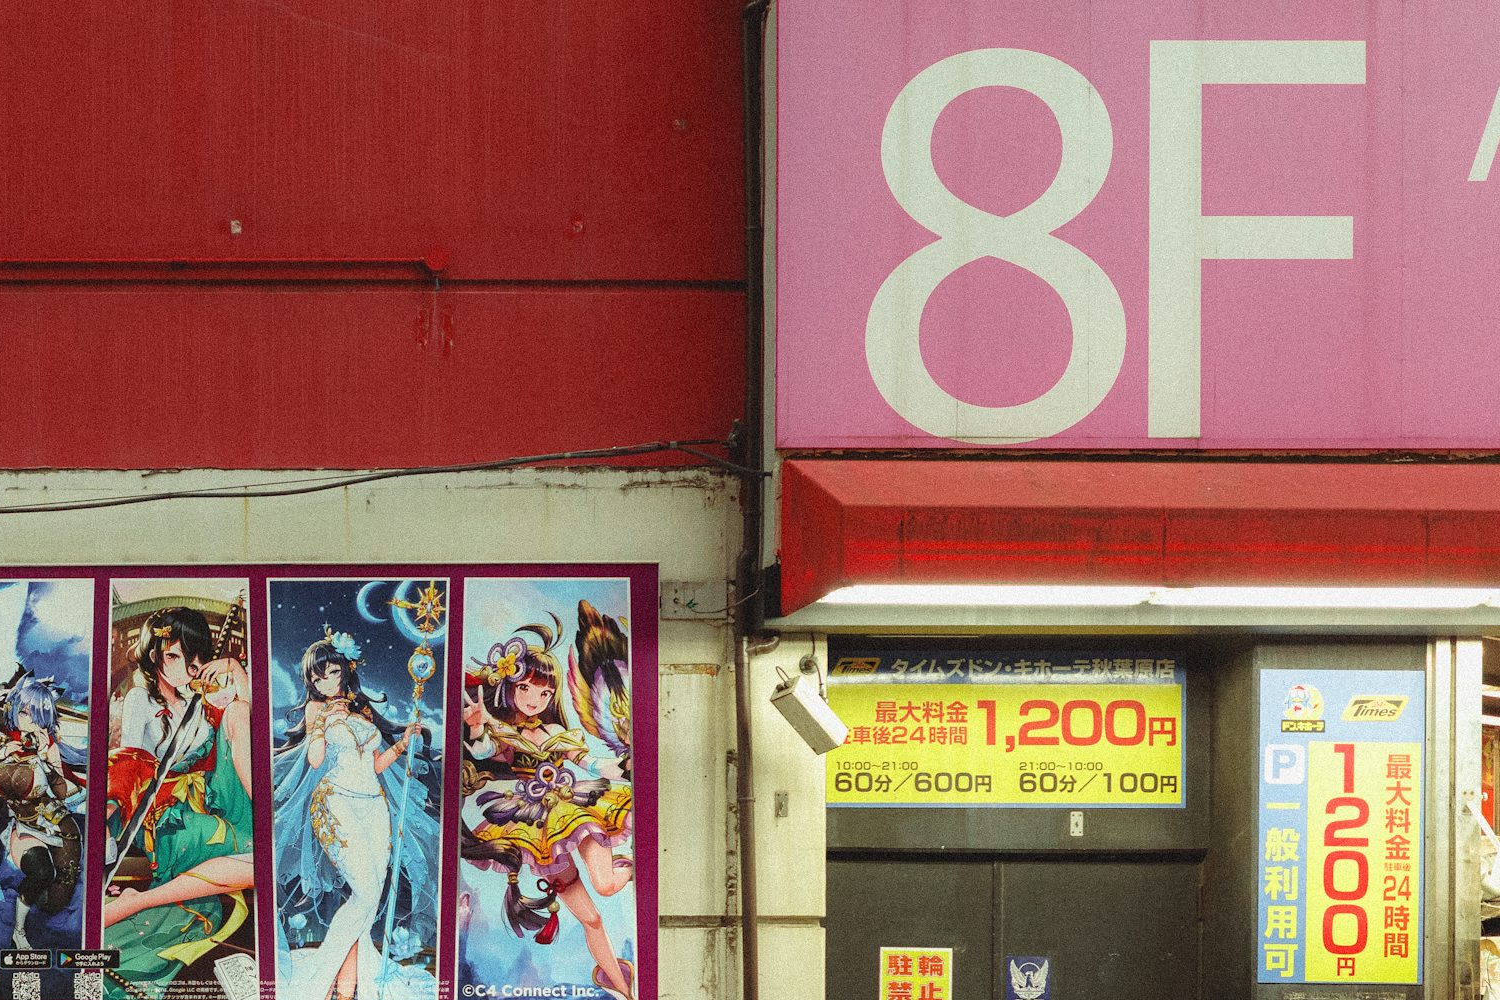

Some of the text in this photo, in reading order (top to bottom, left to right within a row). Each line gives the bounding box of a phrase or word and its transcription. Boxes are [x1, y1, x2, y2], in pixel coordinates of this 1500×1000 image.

[865, 40, 1366, 444] 8F
[875, 701, 969, 723] 最大料金
[978, 700, 1177, 752] 1,200円
[1353, 702, 1398, 717] Times
[1385, 754, 1412, 860] 最大料金
[1264, 800, 1301, 979] 一般利用可
[1383, 875, 1412, 959] 24時間
[74, 953, 111, 961] Google Play
[887, 954, 943, 976] 駐輪
[501, 984, 566, 997] Connect
[571, 984, 600, 997] Inc.
